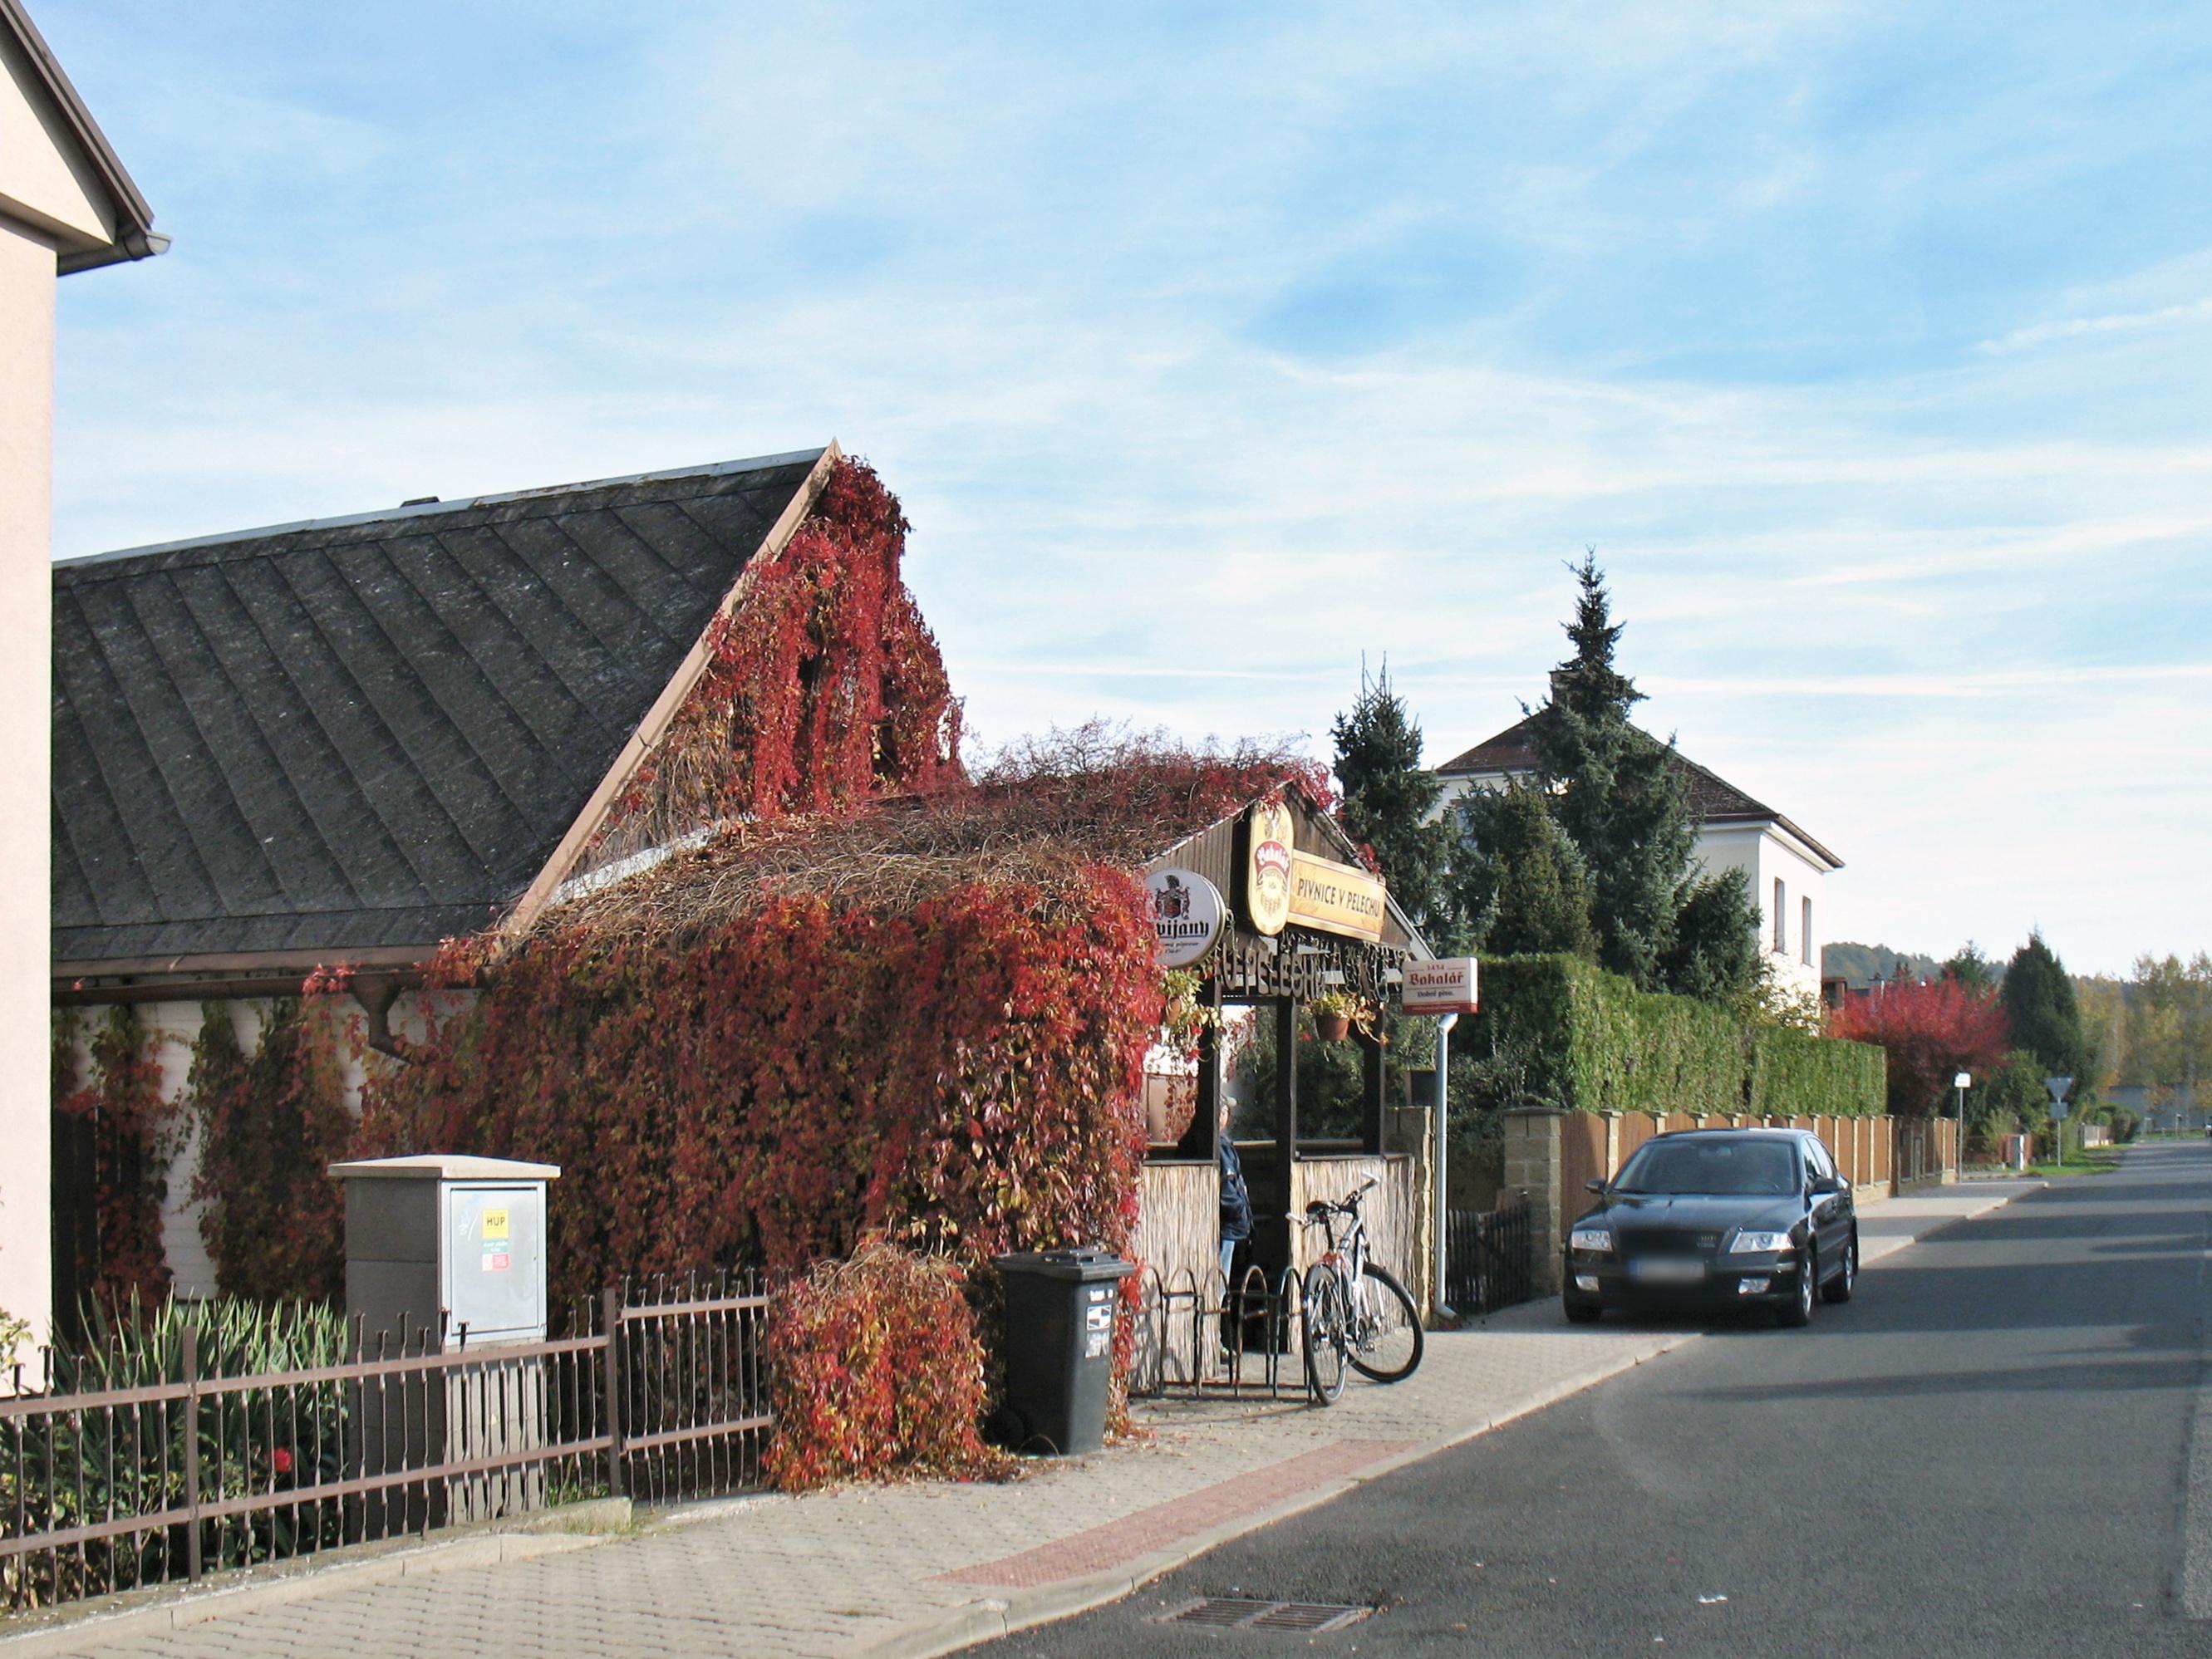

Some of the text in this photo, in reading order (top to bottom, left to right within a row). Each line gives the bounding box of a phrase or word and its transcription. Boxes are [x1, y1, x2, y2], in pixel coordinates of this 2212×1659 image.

[1297, 878, 1381, 917] PIVNICE V PELECHU
[1156, 920, 1209, 939] vijany
[1409, 971, 1464, 986] Bakalář
[487, 1216, 506, 1226] HUP
